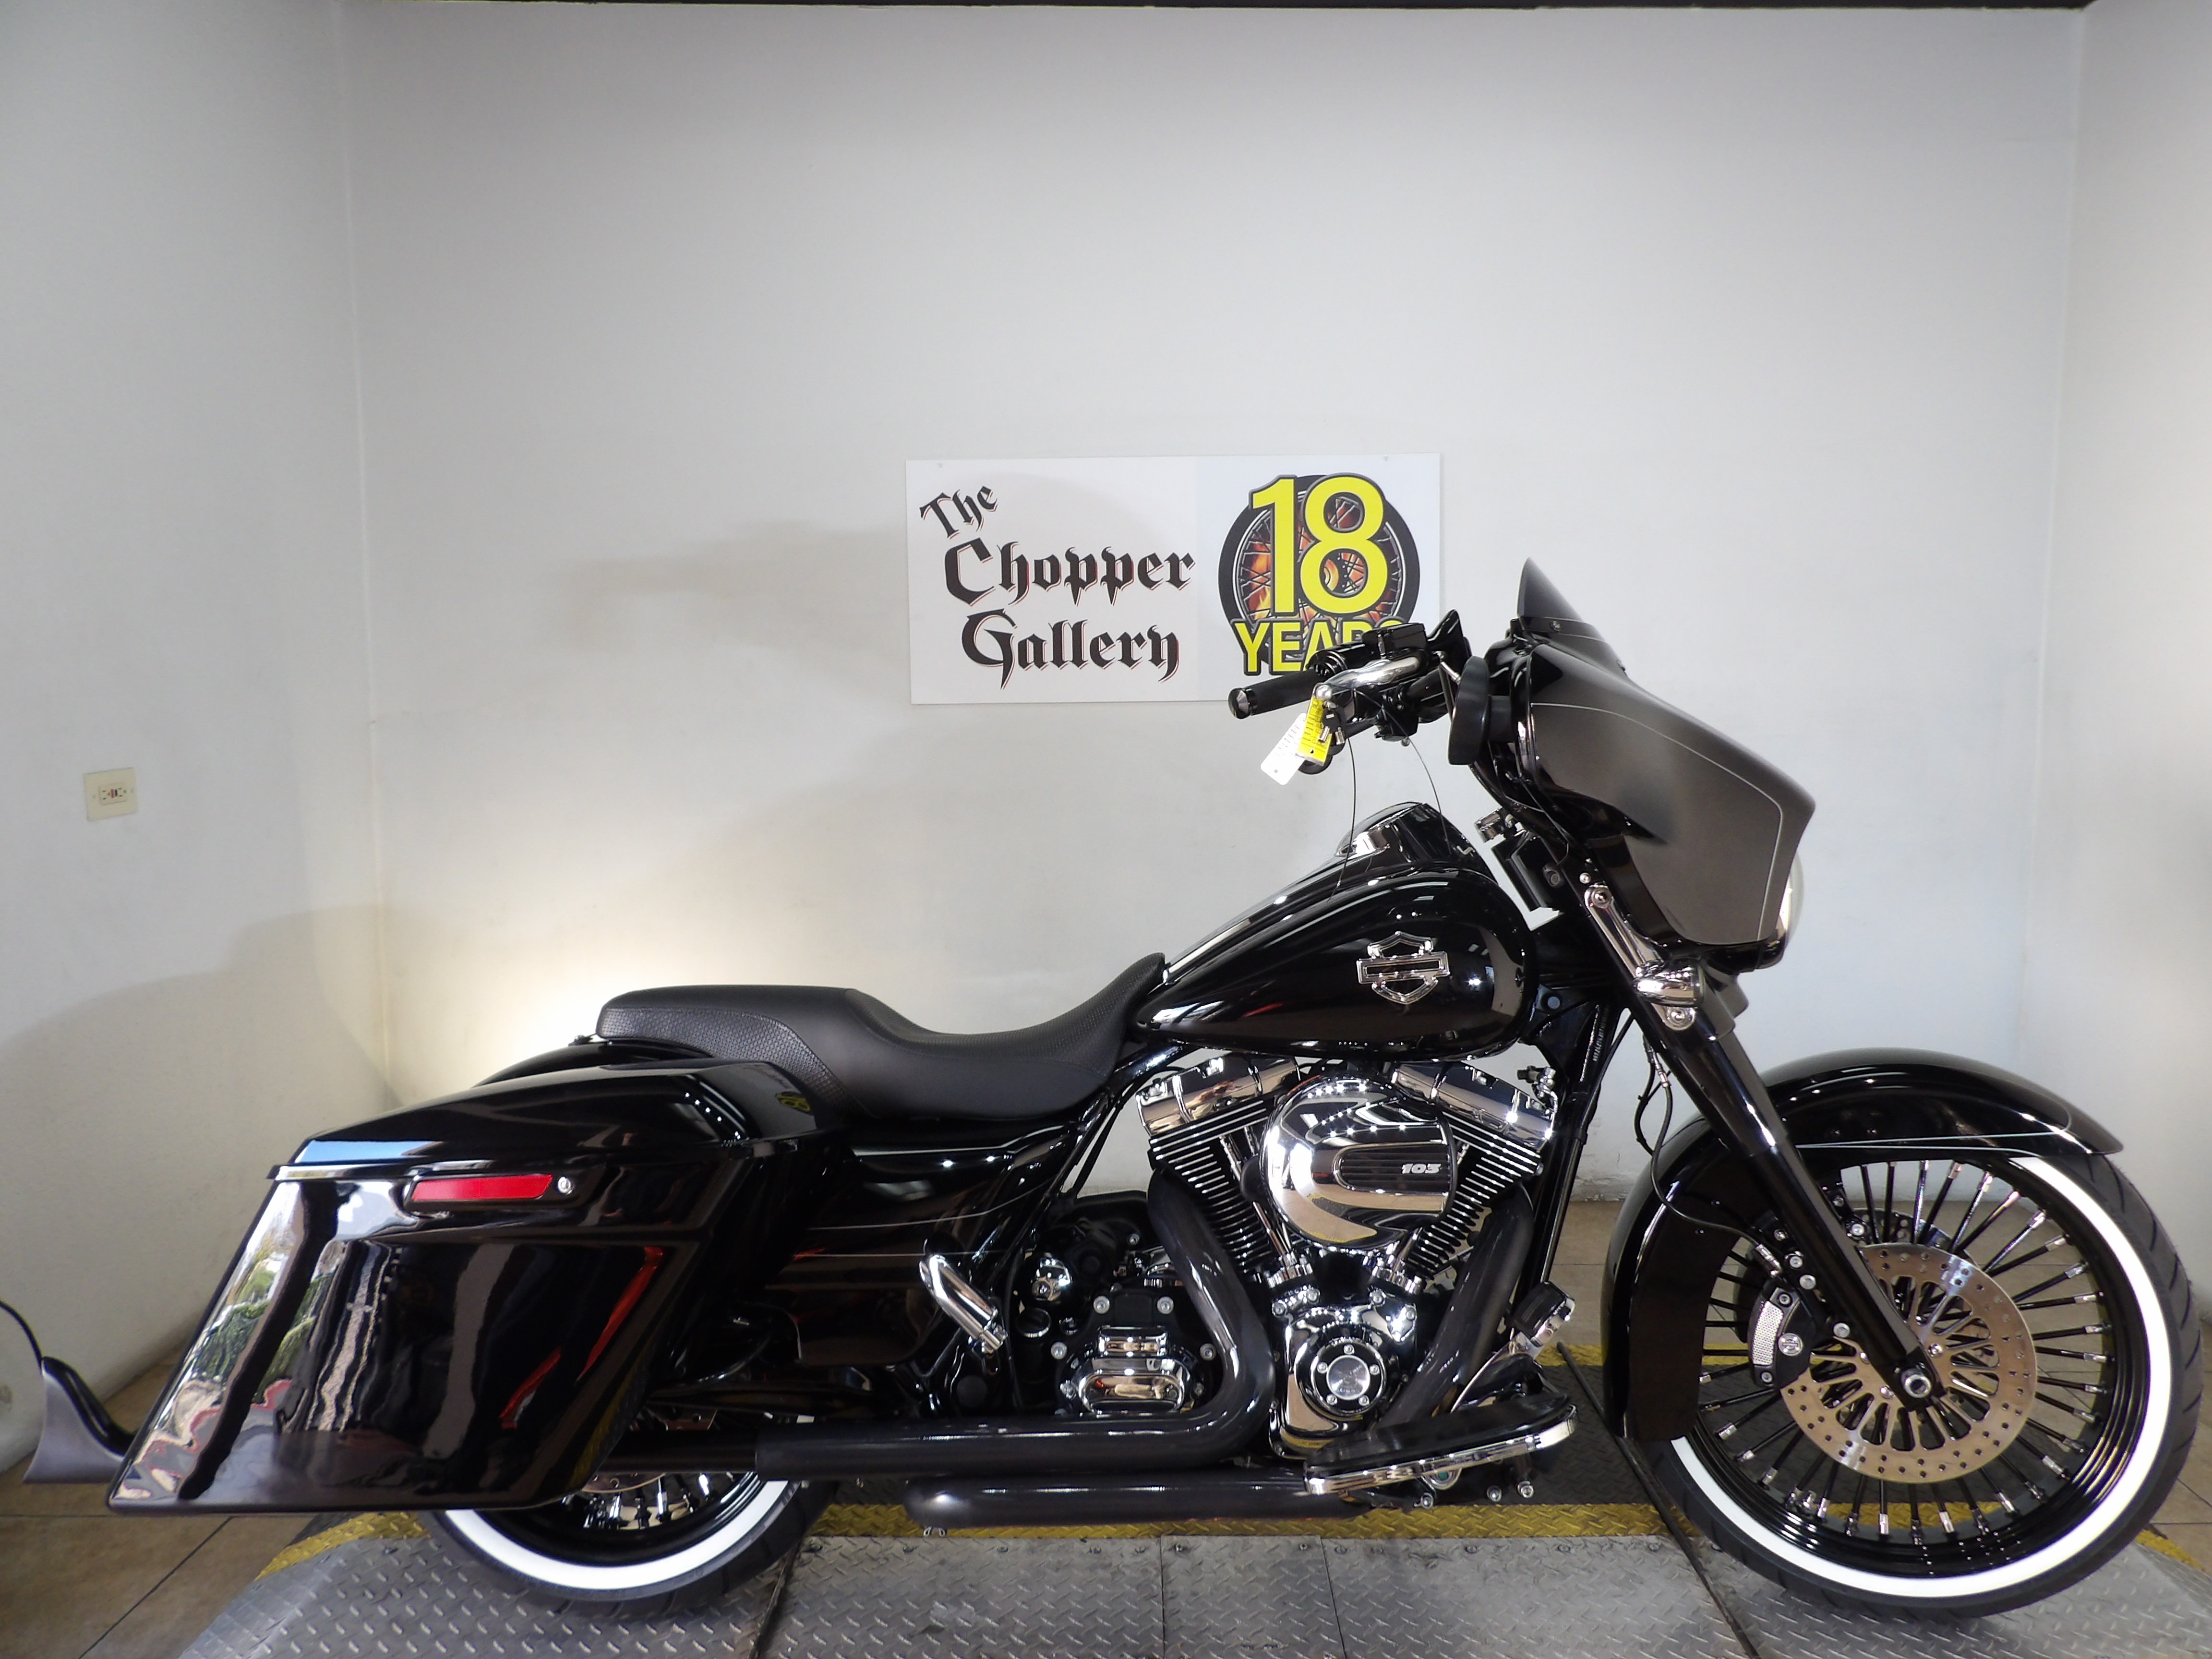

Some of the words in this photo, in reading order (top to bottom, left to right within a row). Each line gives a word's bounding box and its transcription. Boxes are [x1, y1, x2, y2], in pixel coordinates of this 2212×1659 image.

[919, 485, 998, 539] The
[1250, 475, 1389, 615] 18
[944, 537, 1195, 606] Chopper
[961, 608, 1179, 689] Gallery
[1234, 620, 1406, 673] YEA
